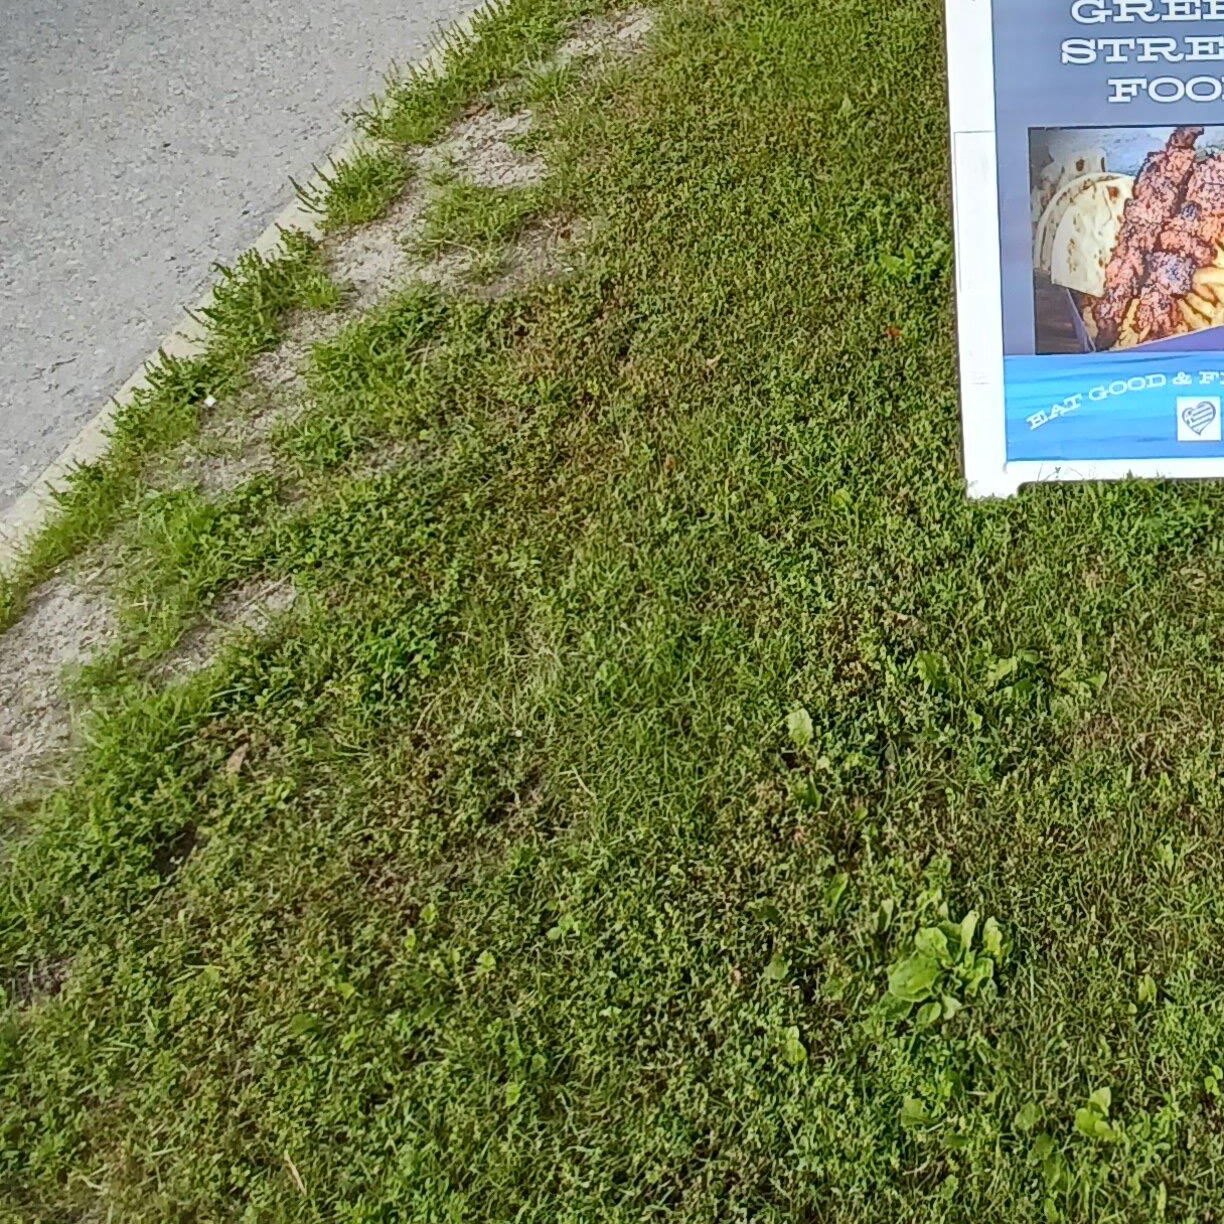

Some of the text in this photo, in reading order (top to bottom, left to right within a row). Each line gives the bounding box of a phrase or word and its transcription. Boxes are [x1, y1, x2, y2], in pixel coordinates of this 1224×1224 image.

[1026, 393, 1083, 430] EAT
[1088, 373, 1166, 401] GOOD
[1172, 371, 1192, 385] &
